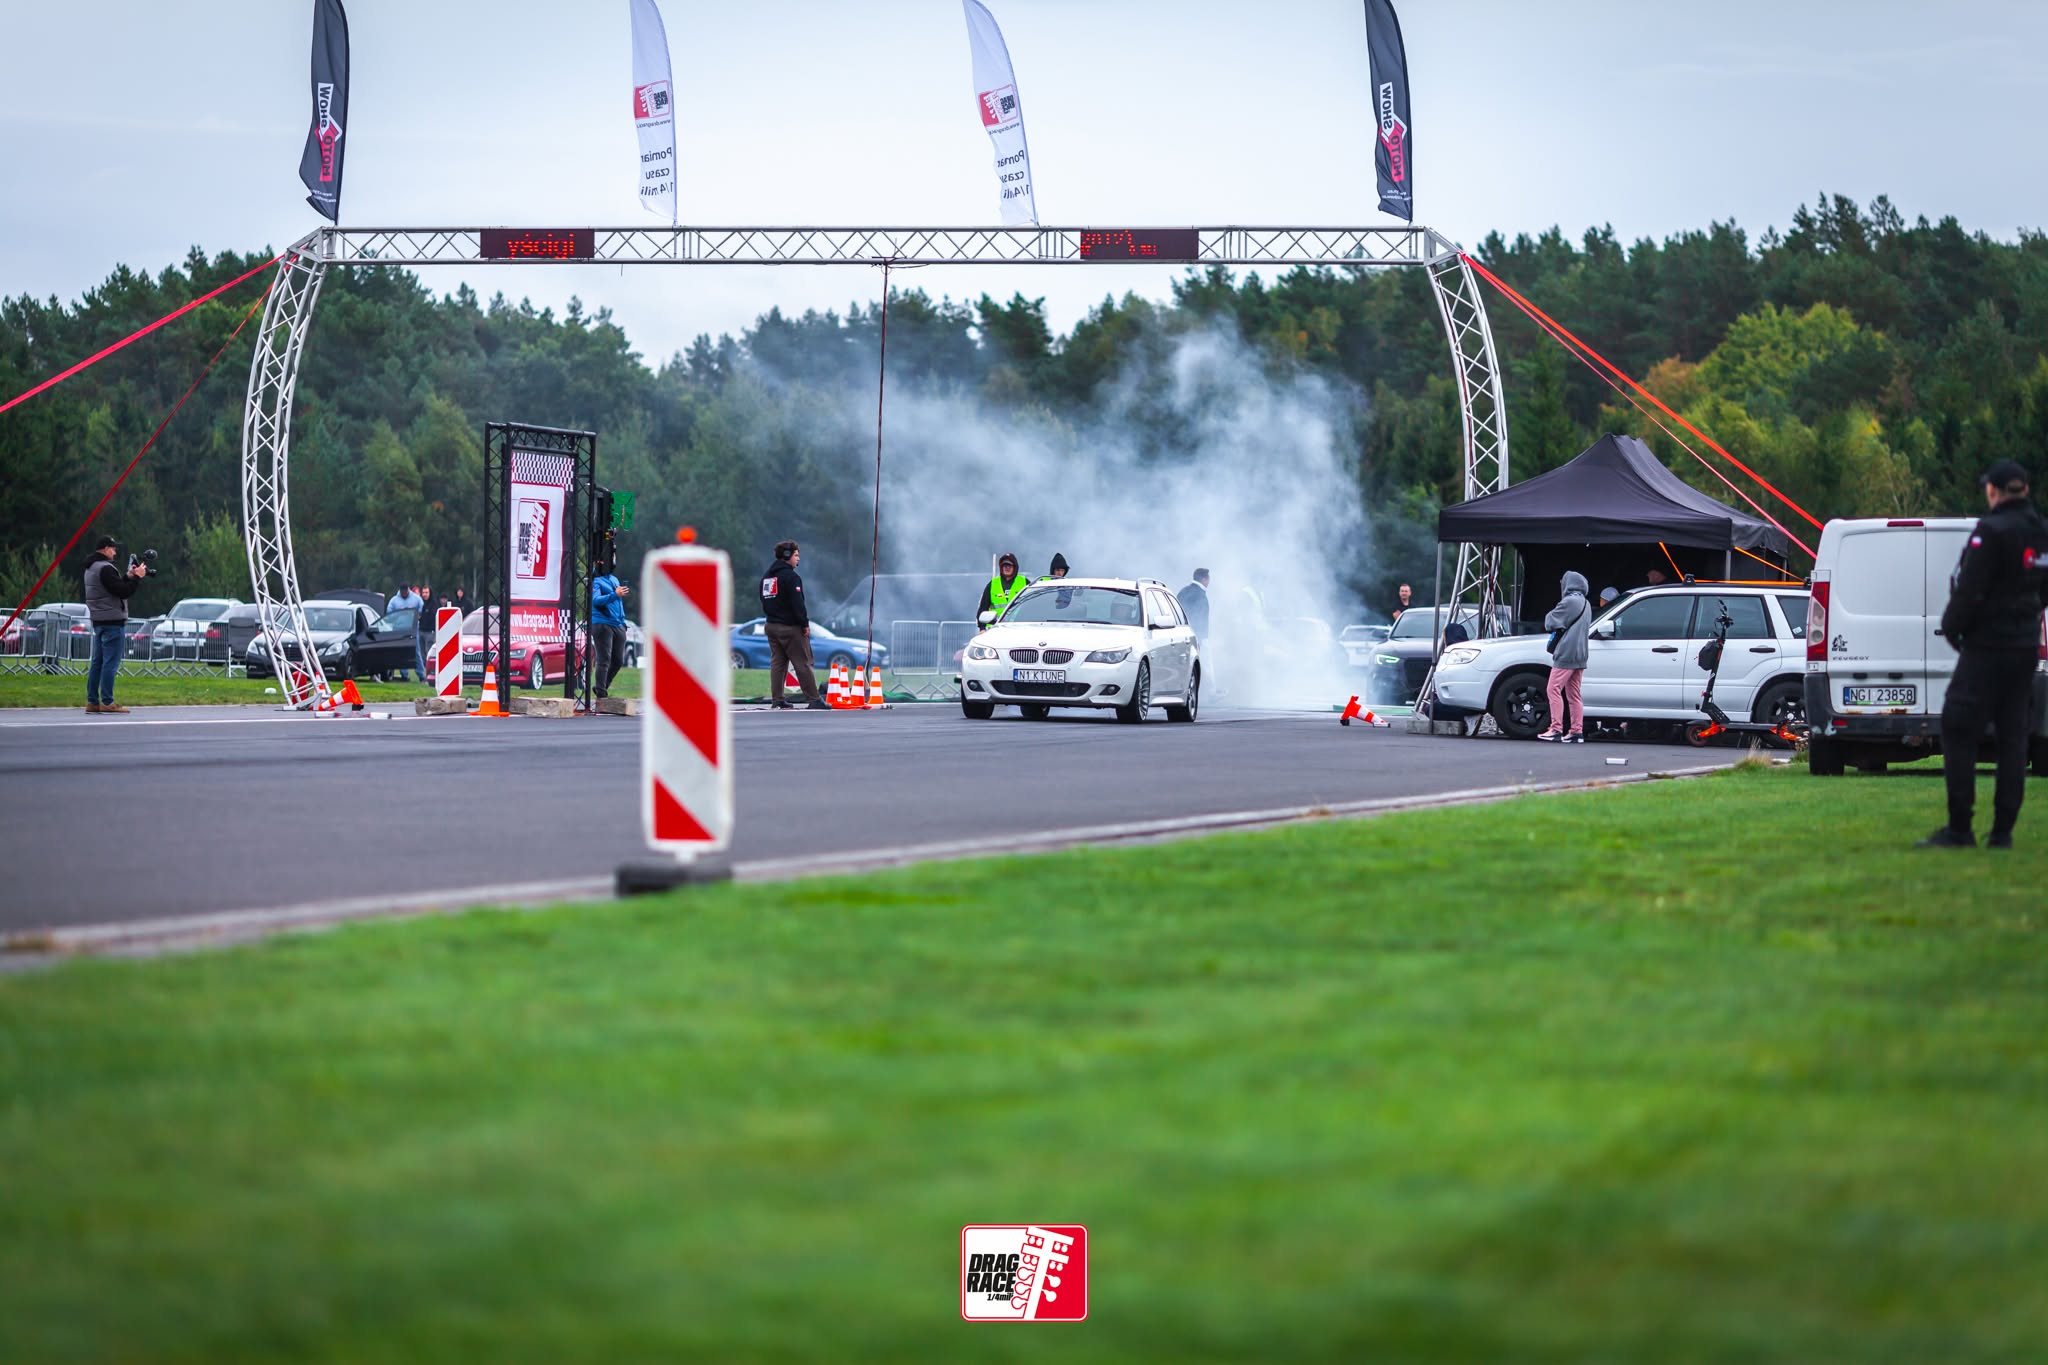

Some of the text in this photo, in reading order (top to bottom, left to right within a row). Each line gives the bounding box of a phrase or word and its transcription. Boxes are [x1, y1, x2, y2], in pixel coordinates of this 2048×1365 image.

[519, 522, 532, 538] DRAG
[1019, 671, 1064, 681] N1 KTUNE
[1850, 689, 1913, 702] NGI 23858
